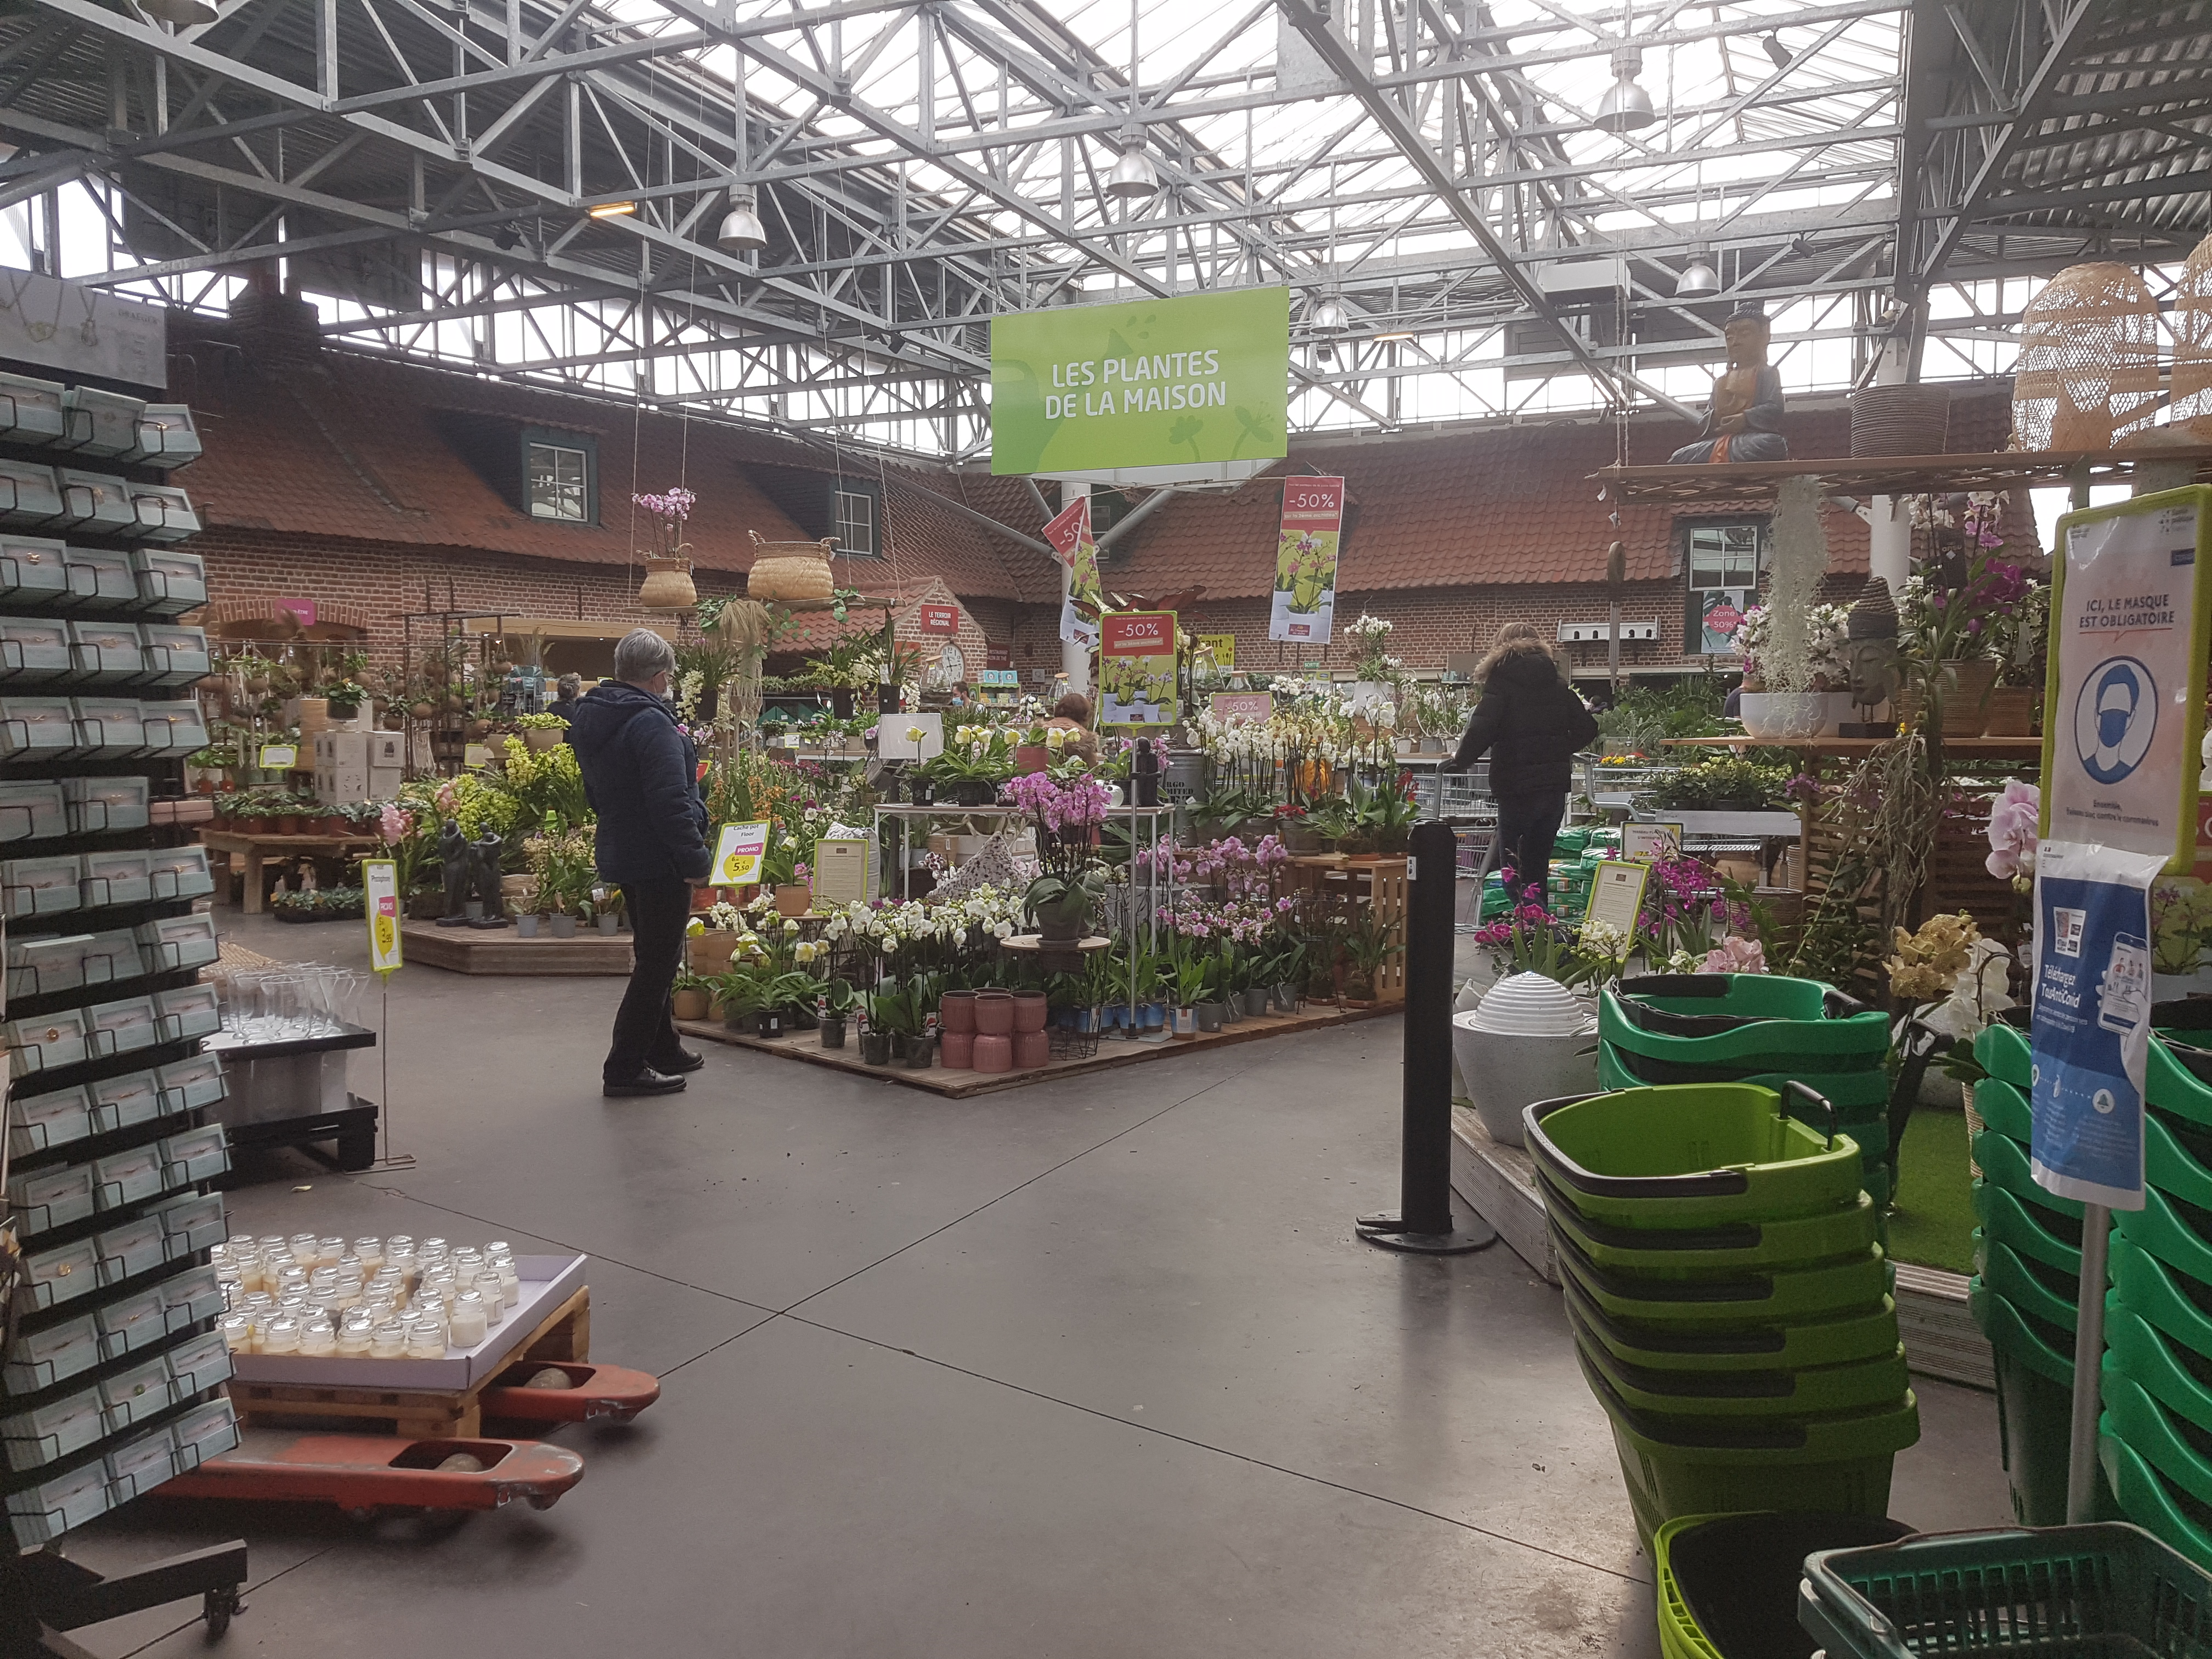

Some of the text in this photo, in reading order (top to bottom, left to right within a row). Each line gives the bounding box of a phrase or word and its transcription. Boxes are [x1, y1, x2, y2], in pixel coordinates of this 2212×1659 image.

[1053, 349, 1218, 388] LES PLANTES
[1046, 381, 1226, 419] DE LA MAISON
[1289, 493, 1334, 508] -50%
[2086, 594, 2170, 613] ICI, LE MASQUE
[930, 618, 950, 627] RÉGIONAL
[2079, 610, 2175, 628] EST OBLIGATOIRE
[1118, 623, 1159, 637] -50%
[733, 862, 749, 872] 5,50
